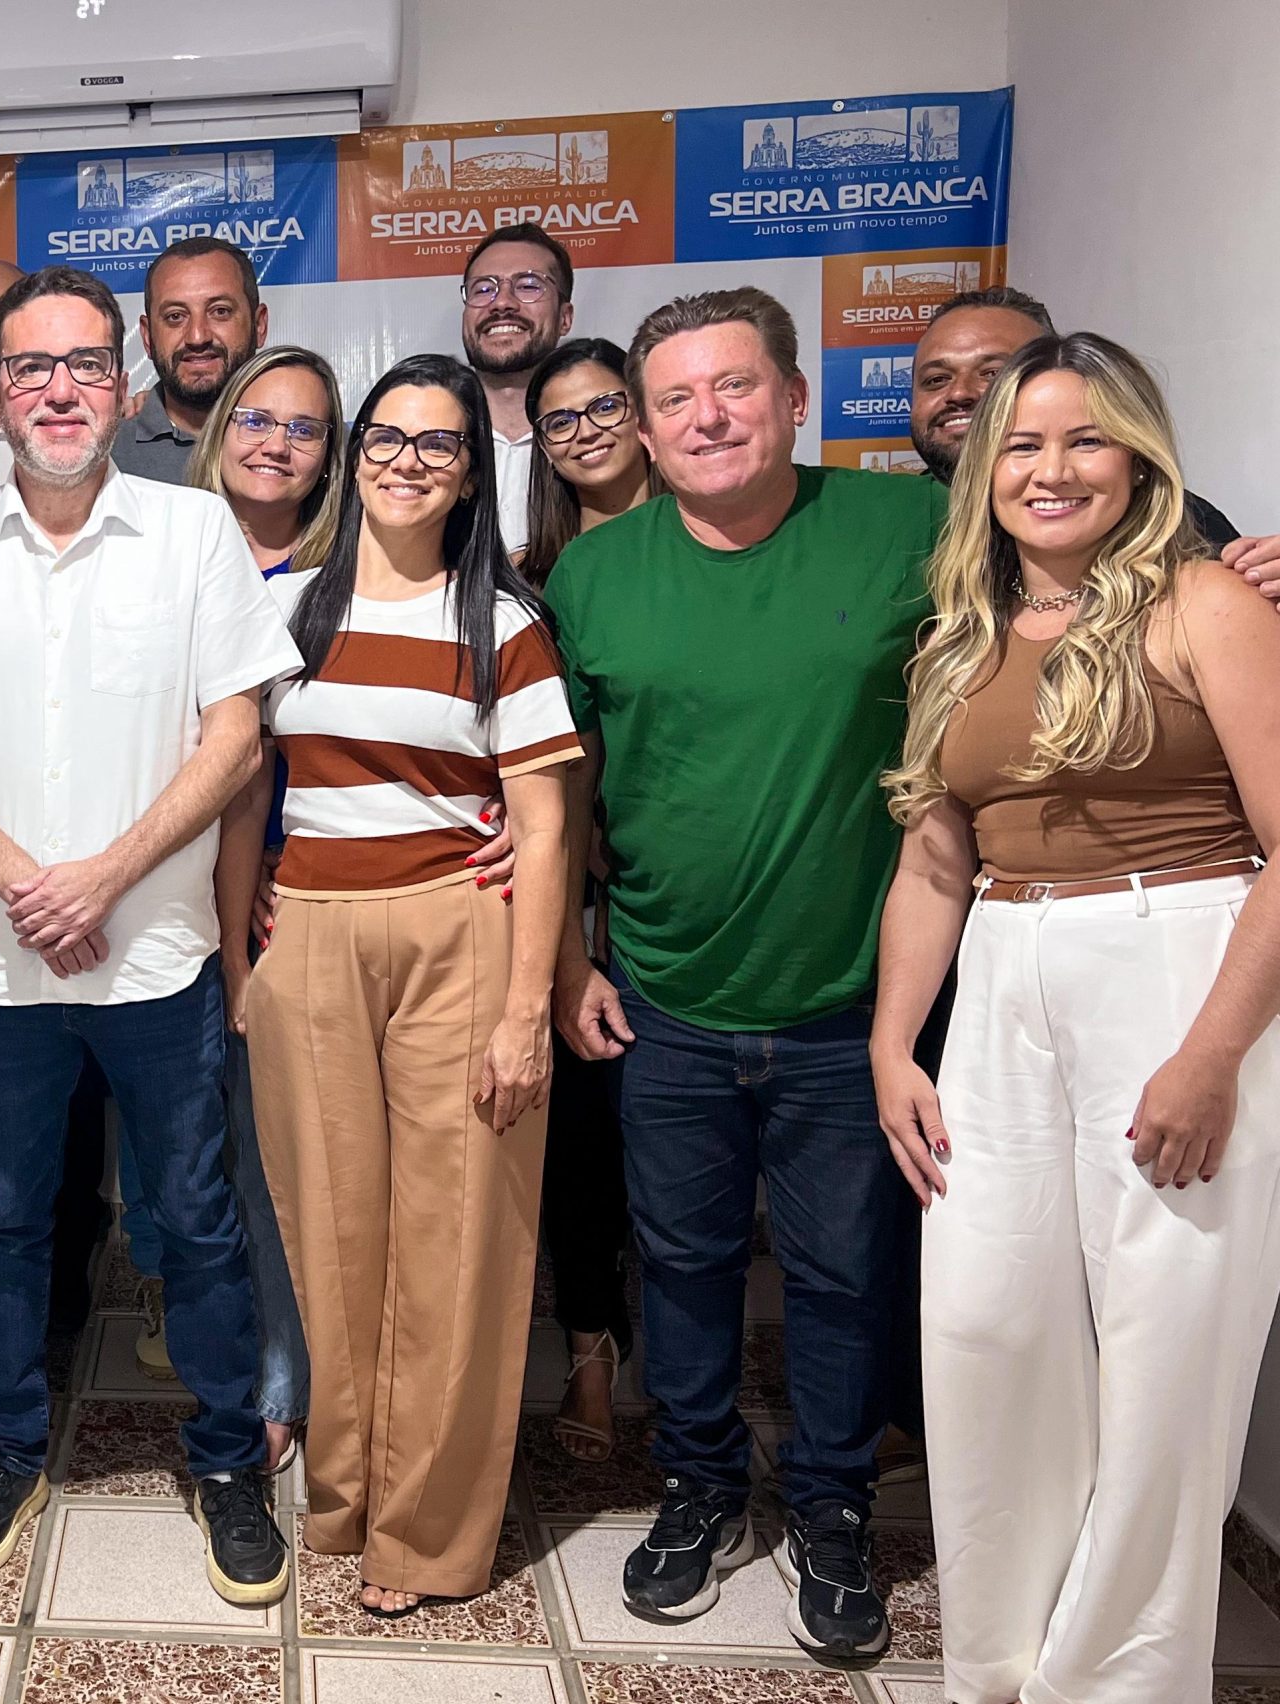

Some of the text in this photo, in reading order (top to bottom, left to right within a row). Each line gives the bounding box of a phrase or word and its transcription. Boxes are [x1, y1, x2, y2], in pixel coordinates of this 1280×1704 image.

[742, 165, 961, 186] GOVERNO MUNICIPAL DE
[402, 188, 608, 208] GOVERNO MUNICIPAL DE
[709, 175, 989, 217] SERRA BRANCA
[160, 207, 251, 220] MUNICIPAL
[257, 206, 275, 215] DE
[370, 199, 639, 238] SERRA BRANCA
[753, 214, 948, 236] Juntos em um novo tempo
[48, 226, 160, 255] SERRA
[414, 244, 462, 256] Juntos
[89, 260, 135, 272] Juntos
[842, 305, 914, 324] SERRA
[869, 326, 899, 334] Juntos
[841, 397, 911, 415] SERRA
[868, 418, 897, 426] Juntos
